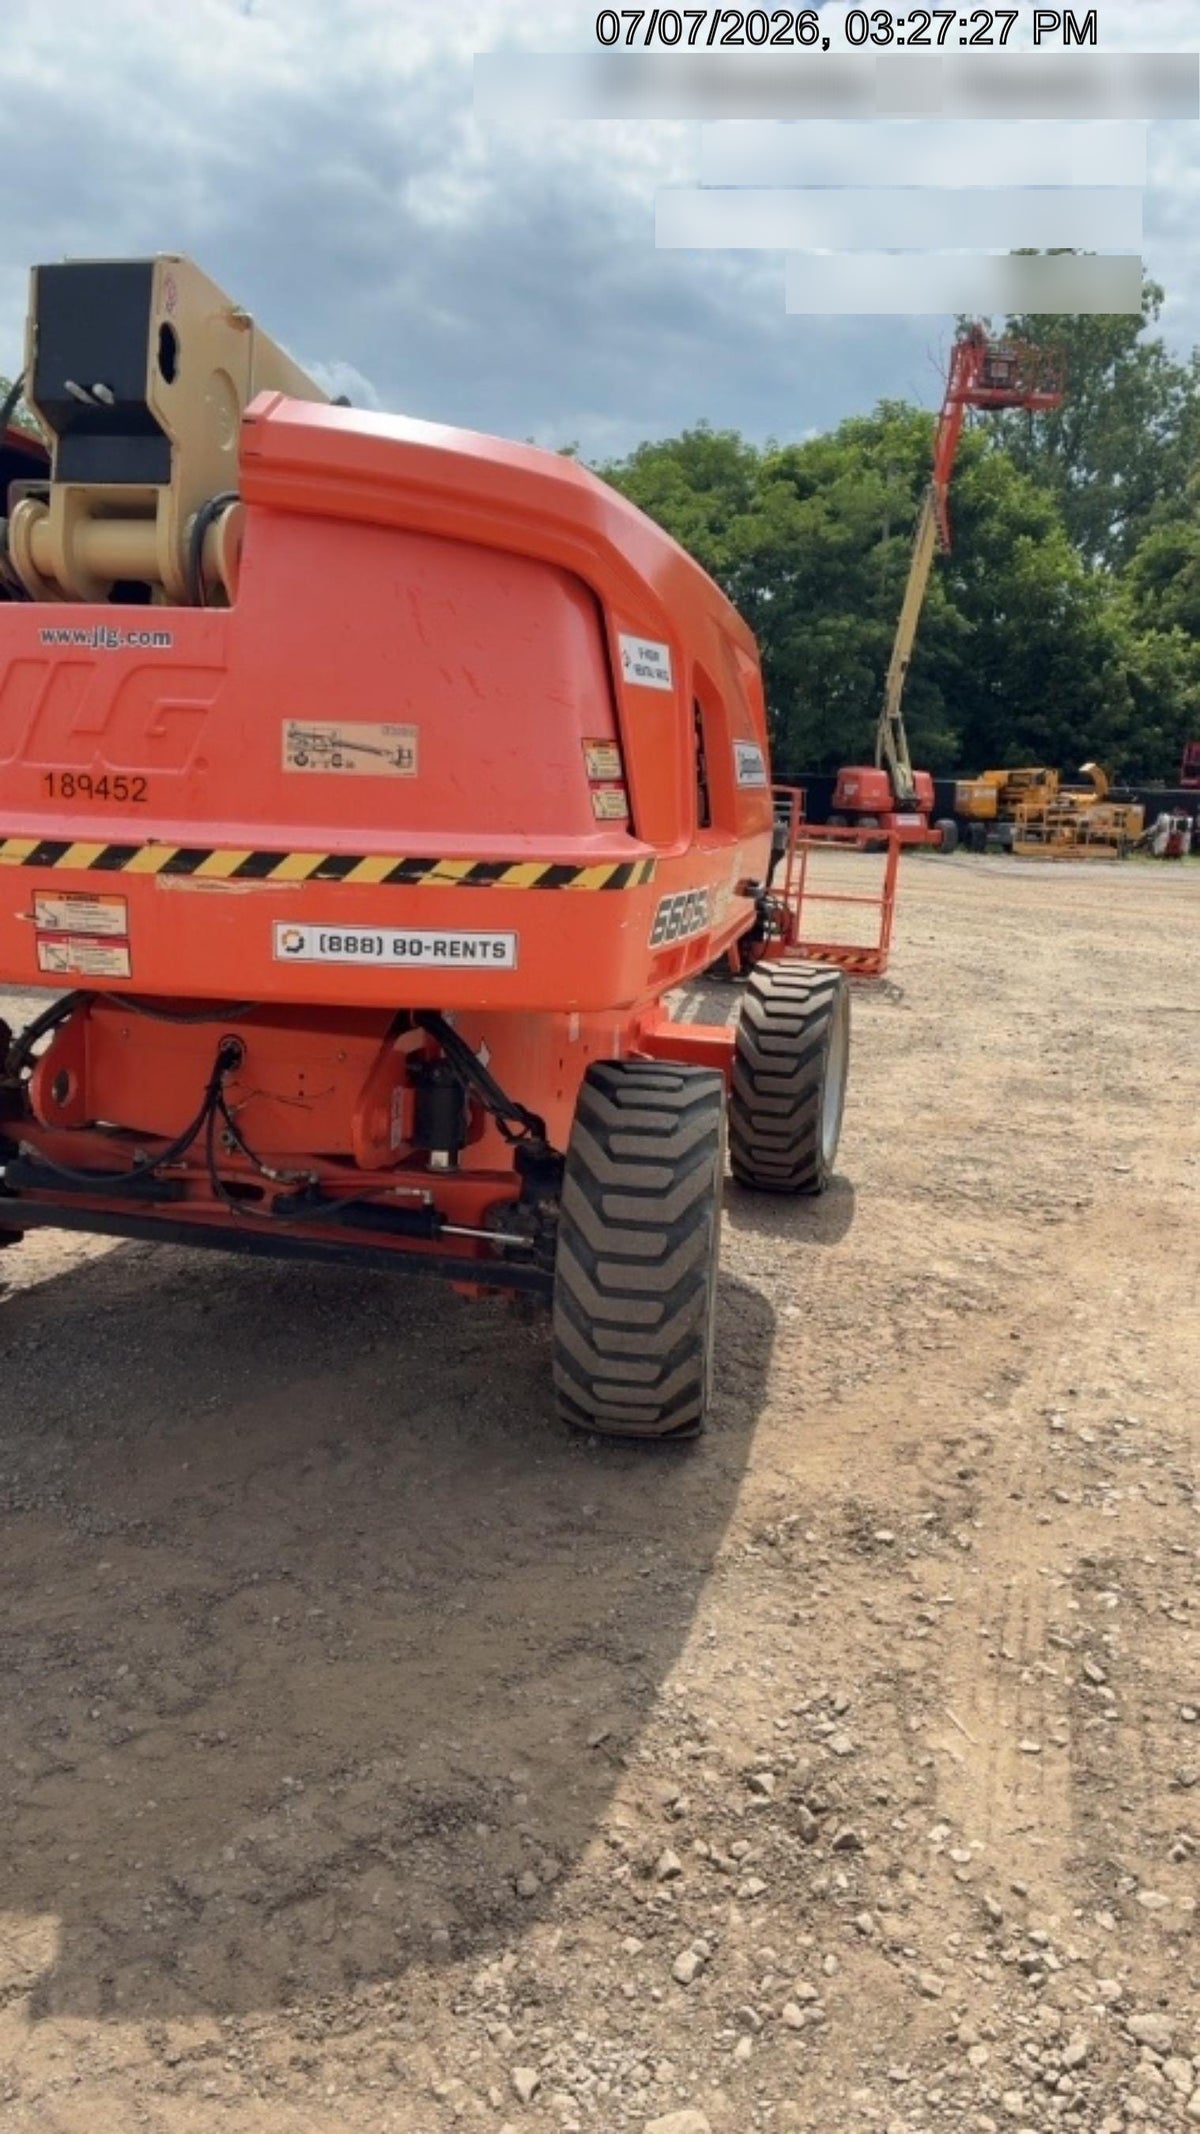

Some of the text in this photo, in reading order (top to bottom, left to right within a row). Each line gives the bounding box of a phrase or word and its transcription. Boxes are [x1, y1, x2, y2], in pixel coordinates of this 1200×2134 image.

[40, 625, 172, 648] www.jlg.com
[43, 771, 148, 802] 189452
[319, 933, 507, 959] (888) 80-RENTS
